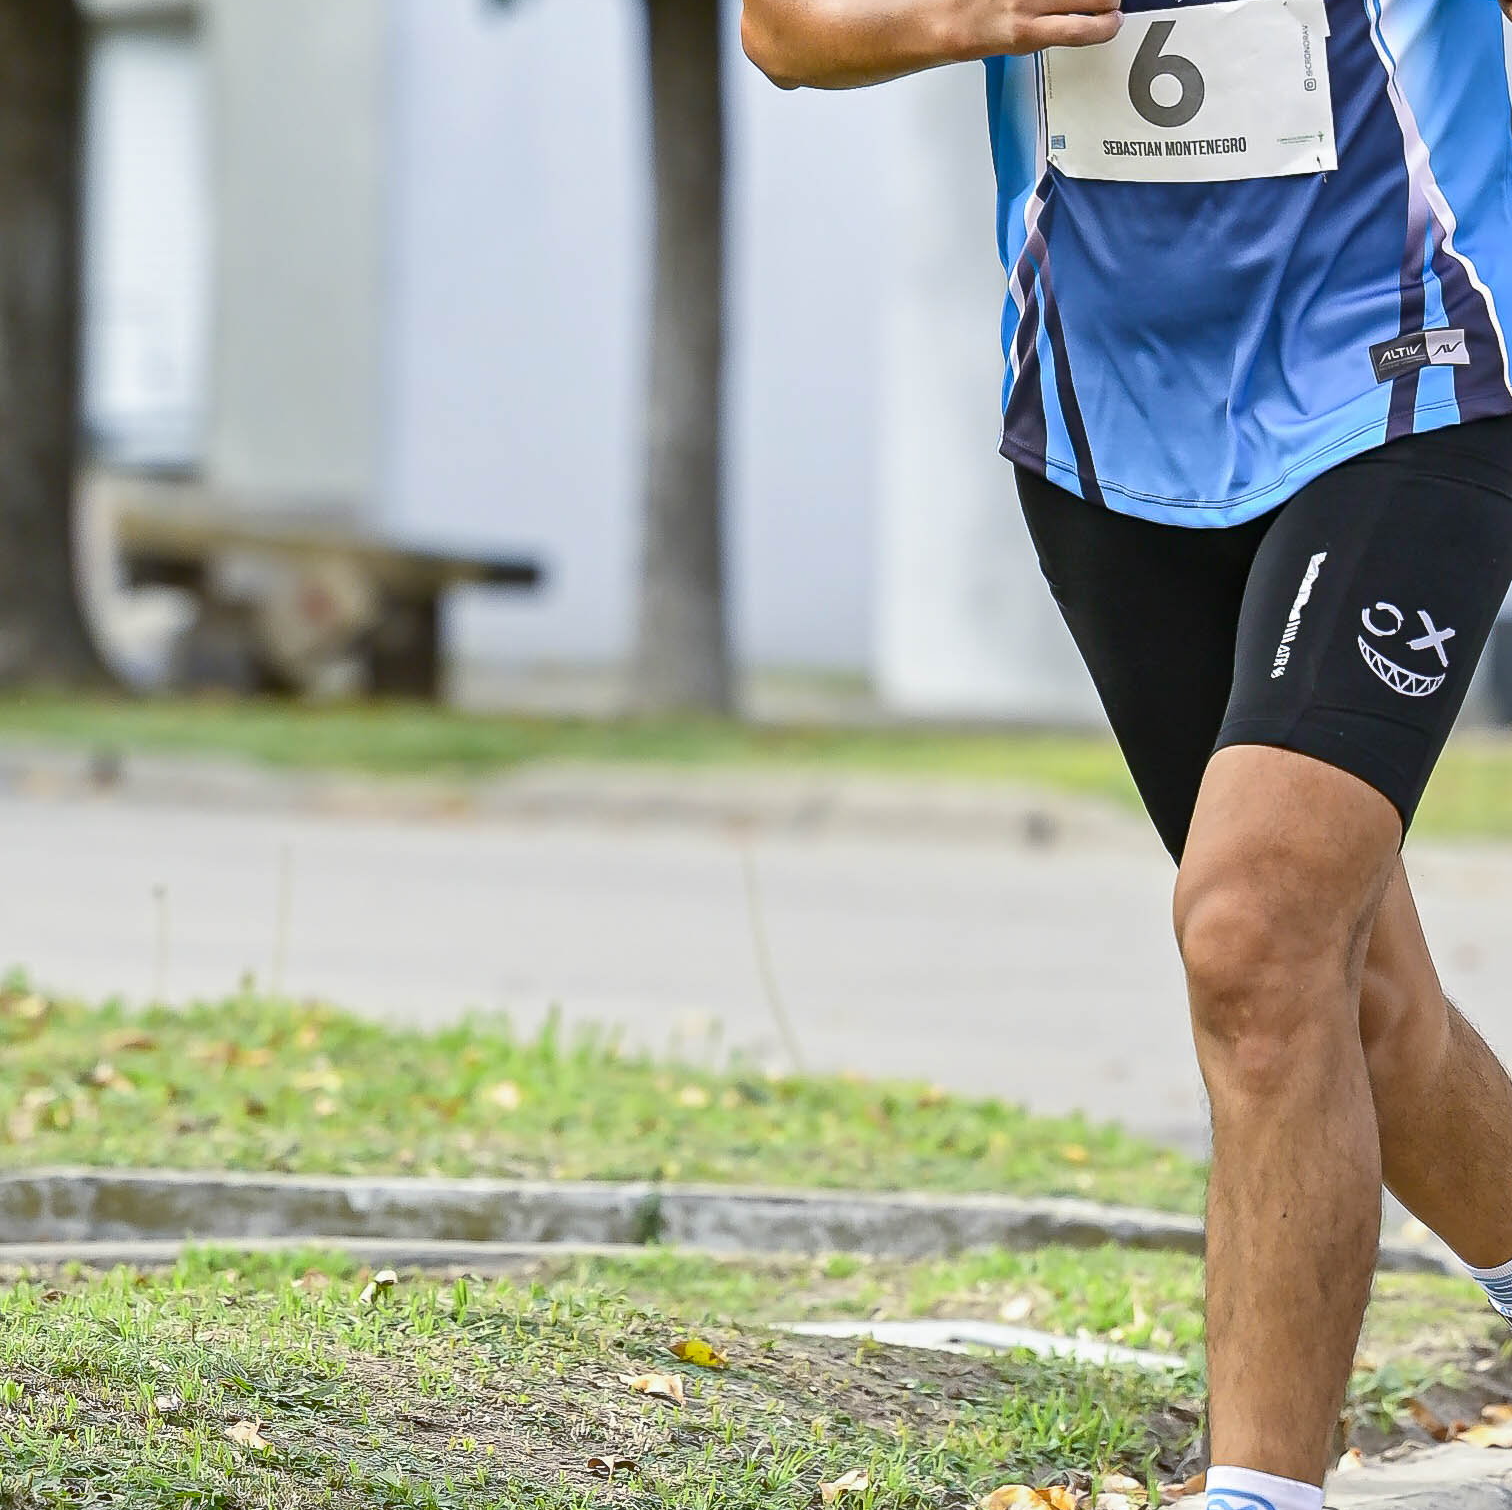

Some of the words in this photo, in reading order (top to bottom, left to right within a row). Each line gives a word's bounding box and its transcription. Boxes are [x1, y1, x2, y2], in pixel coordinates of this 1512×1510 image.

[1128, 20, 1205, 128] 6
[1102, 139, 1163, 156] SEBASTIAN
[1165, 136, 1247, 156] MONTENEGRO
[1379, 342, 1423, 364] ALTIV
